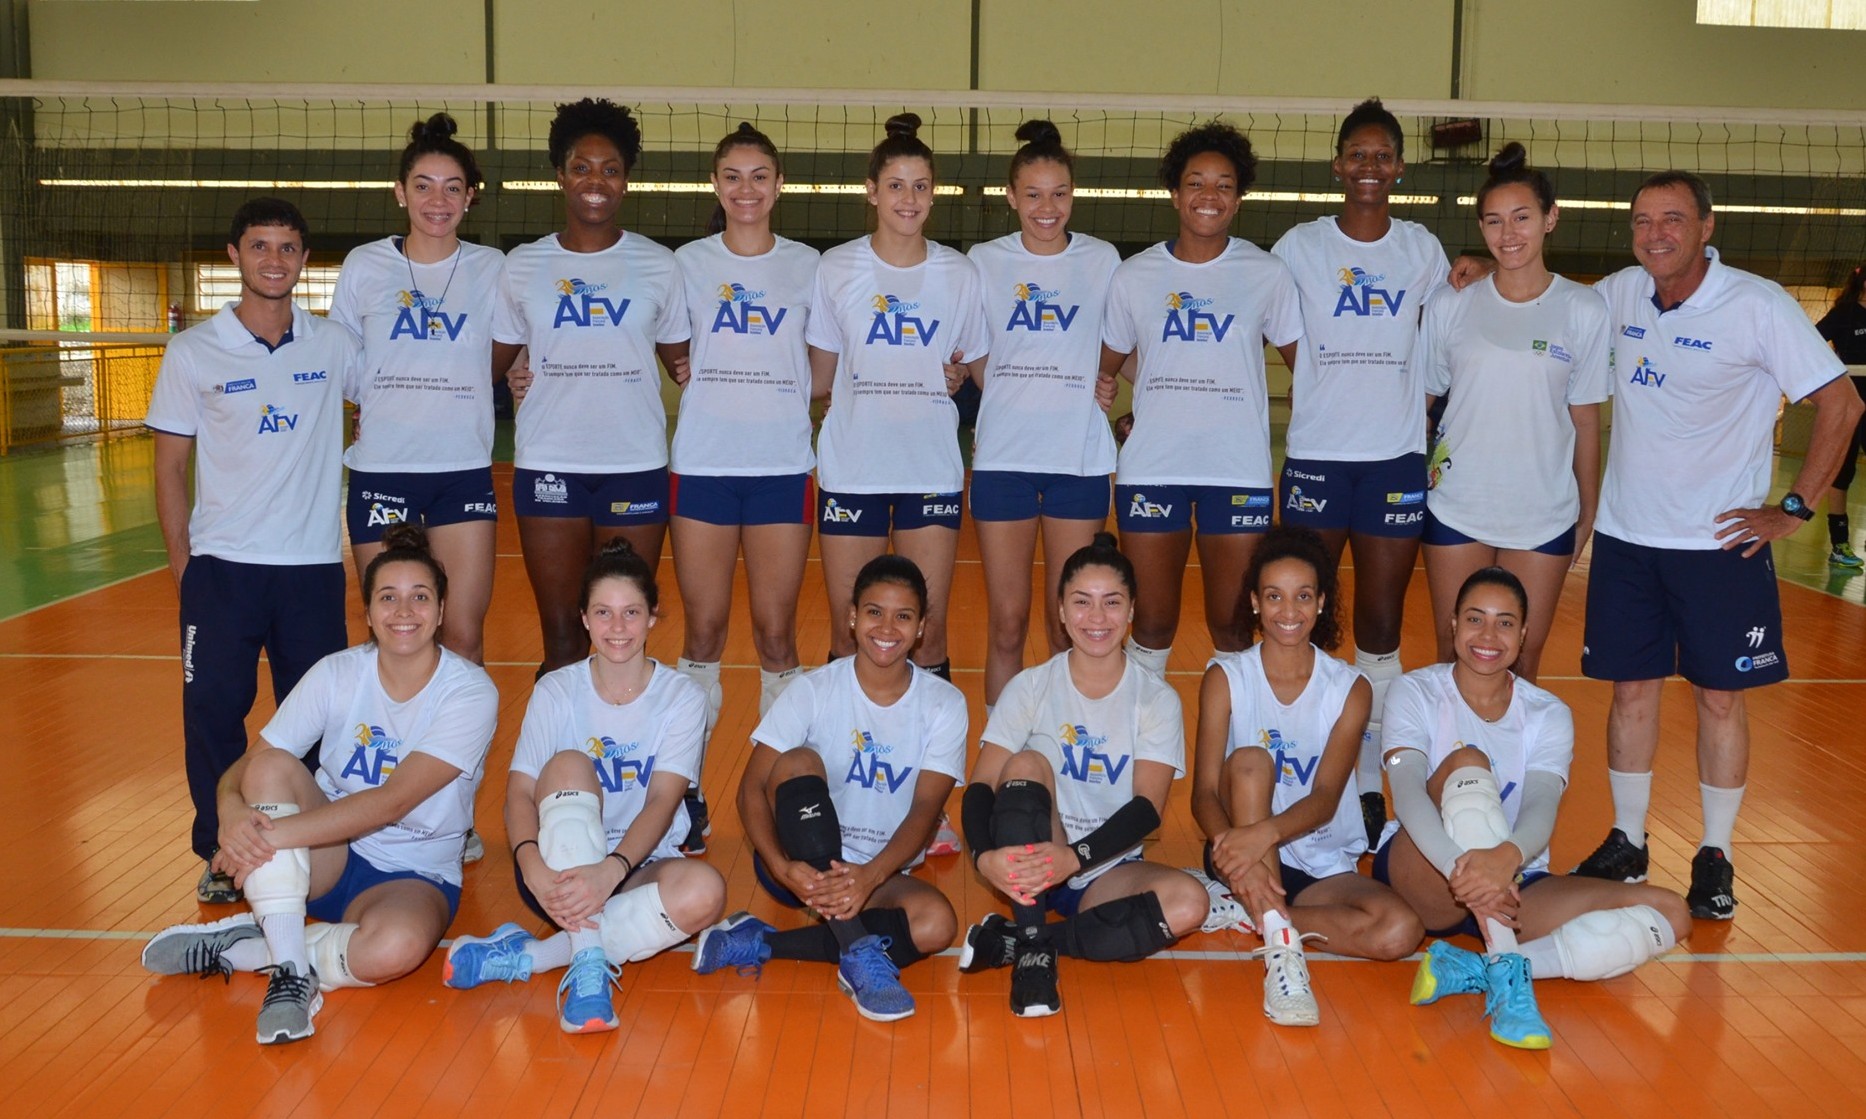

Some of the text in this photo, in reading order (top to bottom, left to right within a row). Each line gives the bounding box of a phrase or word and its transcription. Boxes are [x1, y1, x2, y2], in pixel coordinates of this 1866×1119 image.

[1333, 285, 1406, 317] AFV
[553, 294, 632, 329] AFV
[711, 301, 788, 335] AFV
[1006, 300, 1080, 331] AFV
[865, 312, 940, 347] AFV
[1162, 308, 1235, 343] AFV
[1674, 336, 1713, 350] FEAC
[293, 370, 327, 382] FEAC
[1630, 366, 1666, 388] AFV
[258, 413, 298, 434] AFV
[1293, 470, 1325, 482] Sicredi
[372, 492, 405, 504] Sicredi
[464, 503, 497, 513] FEAC
[1286, 492, 1327, 513] AFV
[367, 507, 408, 527] AFV
[823, 506, 862, 523] AFV
[923, 504, 959, 515] FEAC
[1129, 501, 1172, 518] AFV
[1384, 511, 1424, 523] FEAC
[1231, 515, 1269, 525] FEAC
[185, 624, 197, 669] Unimed
[1753, 655, 1778, 667] FRANCA
[340, 744, 398, 786] AF
[845, 751, 913, 794] AFV
[1017, 952, 1051, 970] NIKE
